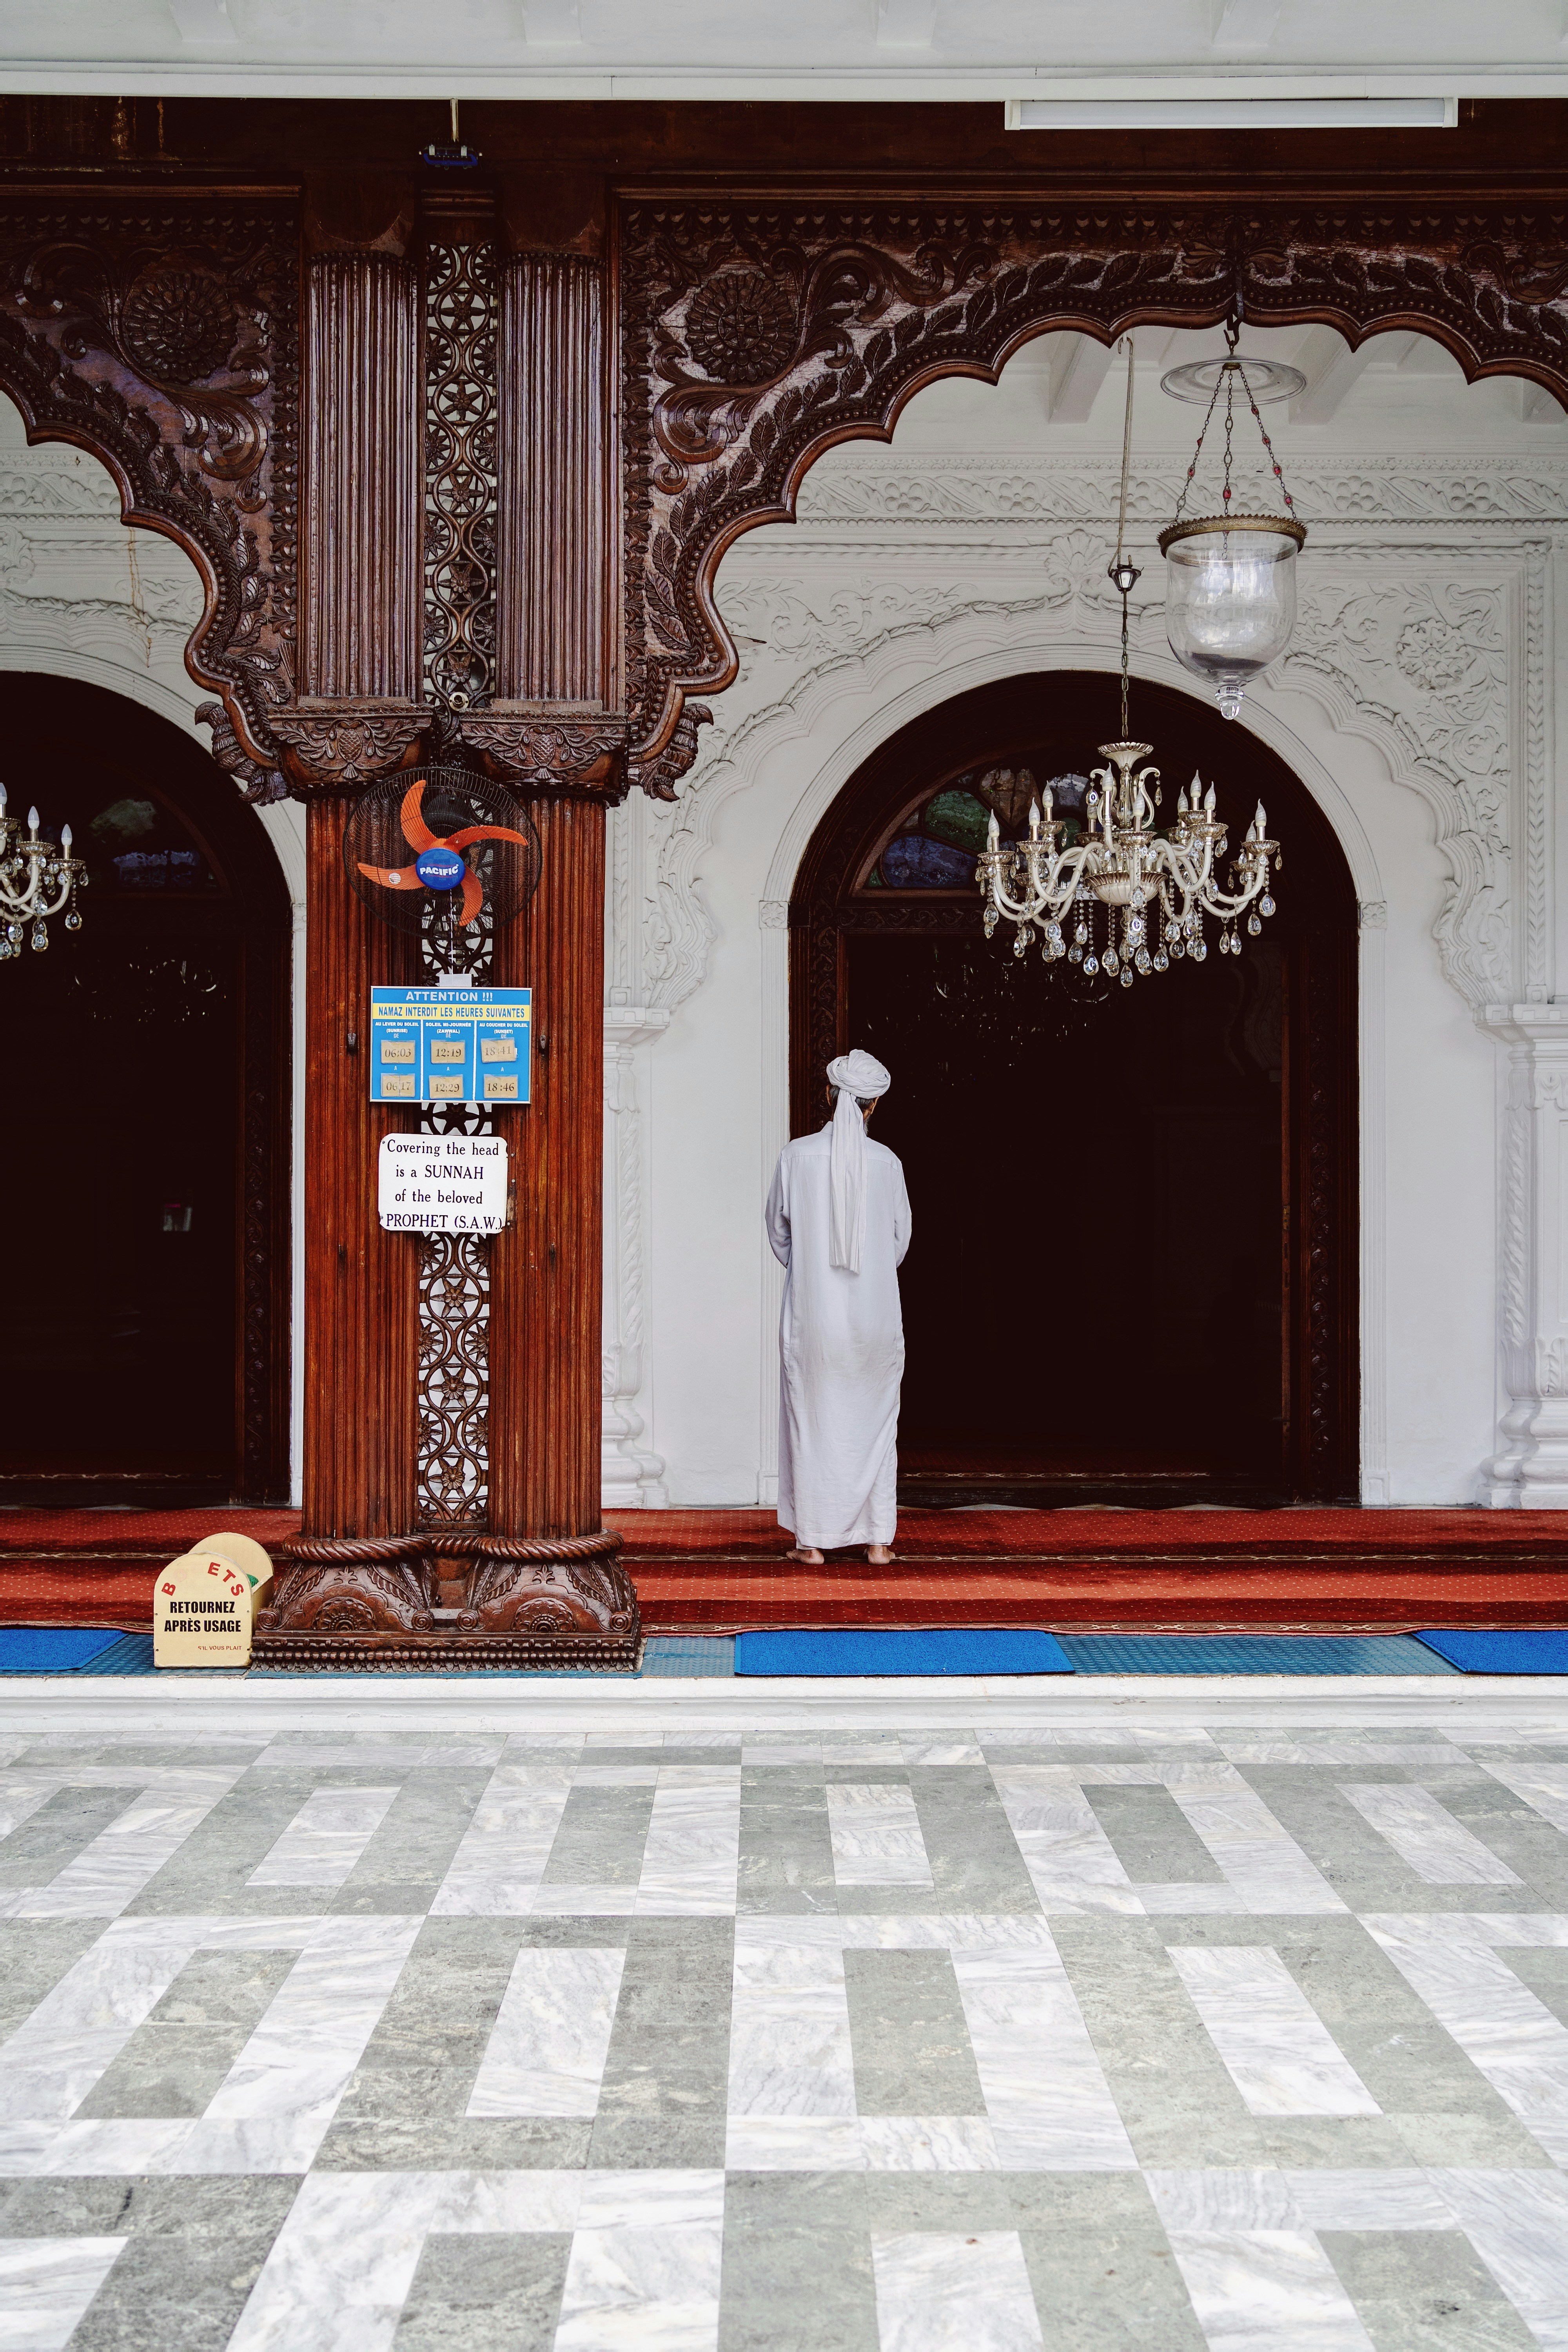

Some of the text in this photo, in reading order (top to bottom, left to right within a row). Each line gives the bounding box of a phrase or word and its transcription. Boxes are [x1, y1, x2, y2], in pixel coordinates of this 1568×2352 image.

[420, 866, 458, 876] PACIFIC
[406, 991, 493, 1002] ATTENTION !!!
[379, 1007, 524, 1018] NAMAZ INTERDIT LES HEURES SUIVANTES
[385, 1049, 411, 1057] 06:03
[436, 1049, 461, 1057] 12:19
[387, 1082, 411, 1091] 0617
[435, 1083, 459, 1092] 12:29
[387, 1139, 499, 1156] Covering the head
[396, 1165, 484, 1179] is a SUNNAH
[395, 1189, 483, 1204] of the beloved
[387, 1214, 502, 1230] PROPHET (S.A.W.)
[170, 1601, 235, 1613] RETOURNEZ
[164, 1618, 241, 1632] APRÈS USAGE
